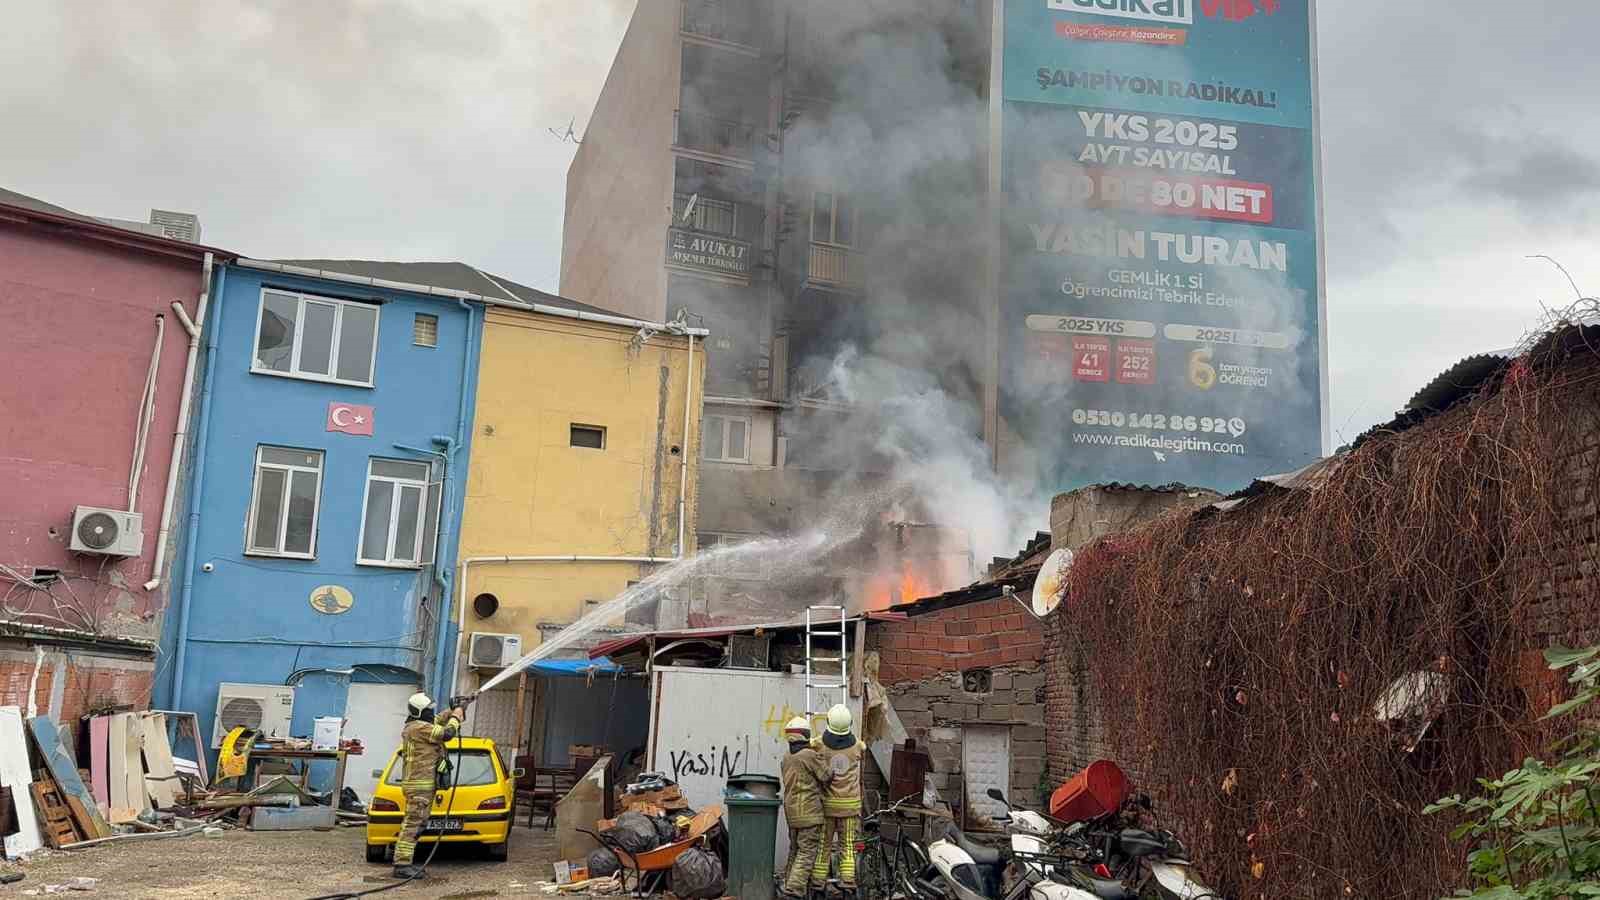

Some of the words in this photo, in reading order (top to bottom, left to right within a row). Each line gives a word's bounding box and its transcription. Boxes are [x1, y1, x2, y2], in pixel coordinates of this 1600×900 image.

[1055, 0, 1185, 17] adikal
[1036, 67, 1163, 96] ŞAMPİYON
[1167, 80, 1277, 109] RADİKAL!
[1078, 111, 1151, 141] YKS
[1154, 119, 1238, 150] 2025
[1078, 143, 1131, 164] AYT
[1132, 147, 1236, 176] SAYISAL
[1201, 184, 1267, 215] NET
[689, 238, 746, 258] AVUKAT
[1150, 231, 1288, 273] TURAN
[1108, 269, 1171, 287] GEMLİK
[1061, 275, 1154, 300] Öğrencimizi
[1155, 287, 1202, 306] Tebrik
[1057, 318, 1095, 331] 2025
[1096, 320, 1125, 334] YKS
[1195, 328, 1232, 342] 2025
[1081, 353, 1099, 367] 41
[1122, 355, 1150, 371] 252
[1072, 408, 1126, 428] 0530
[1128, 412, 1167, 430] 142
[1169, 415, 1198, 432] 86
[1200, 416, 1228, 434] 92
[1072, 432, 1245, 455] www.radikalegitim.com
